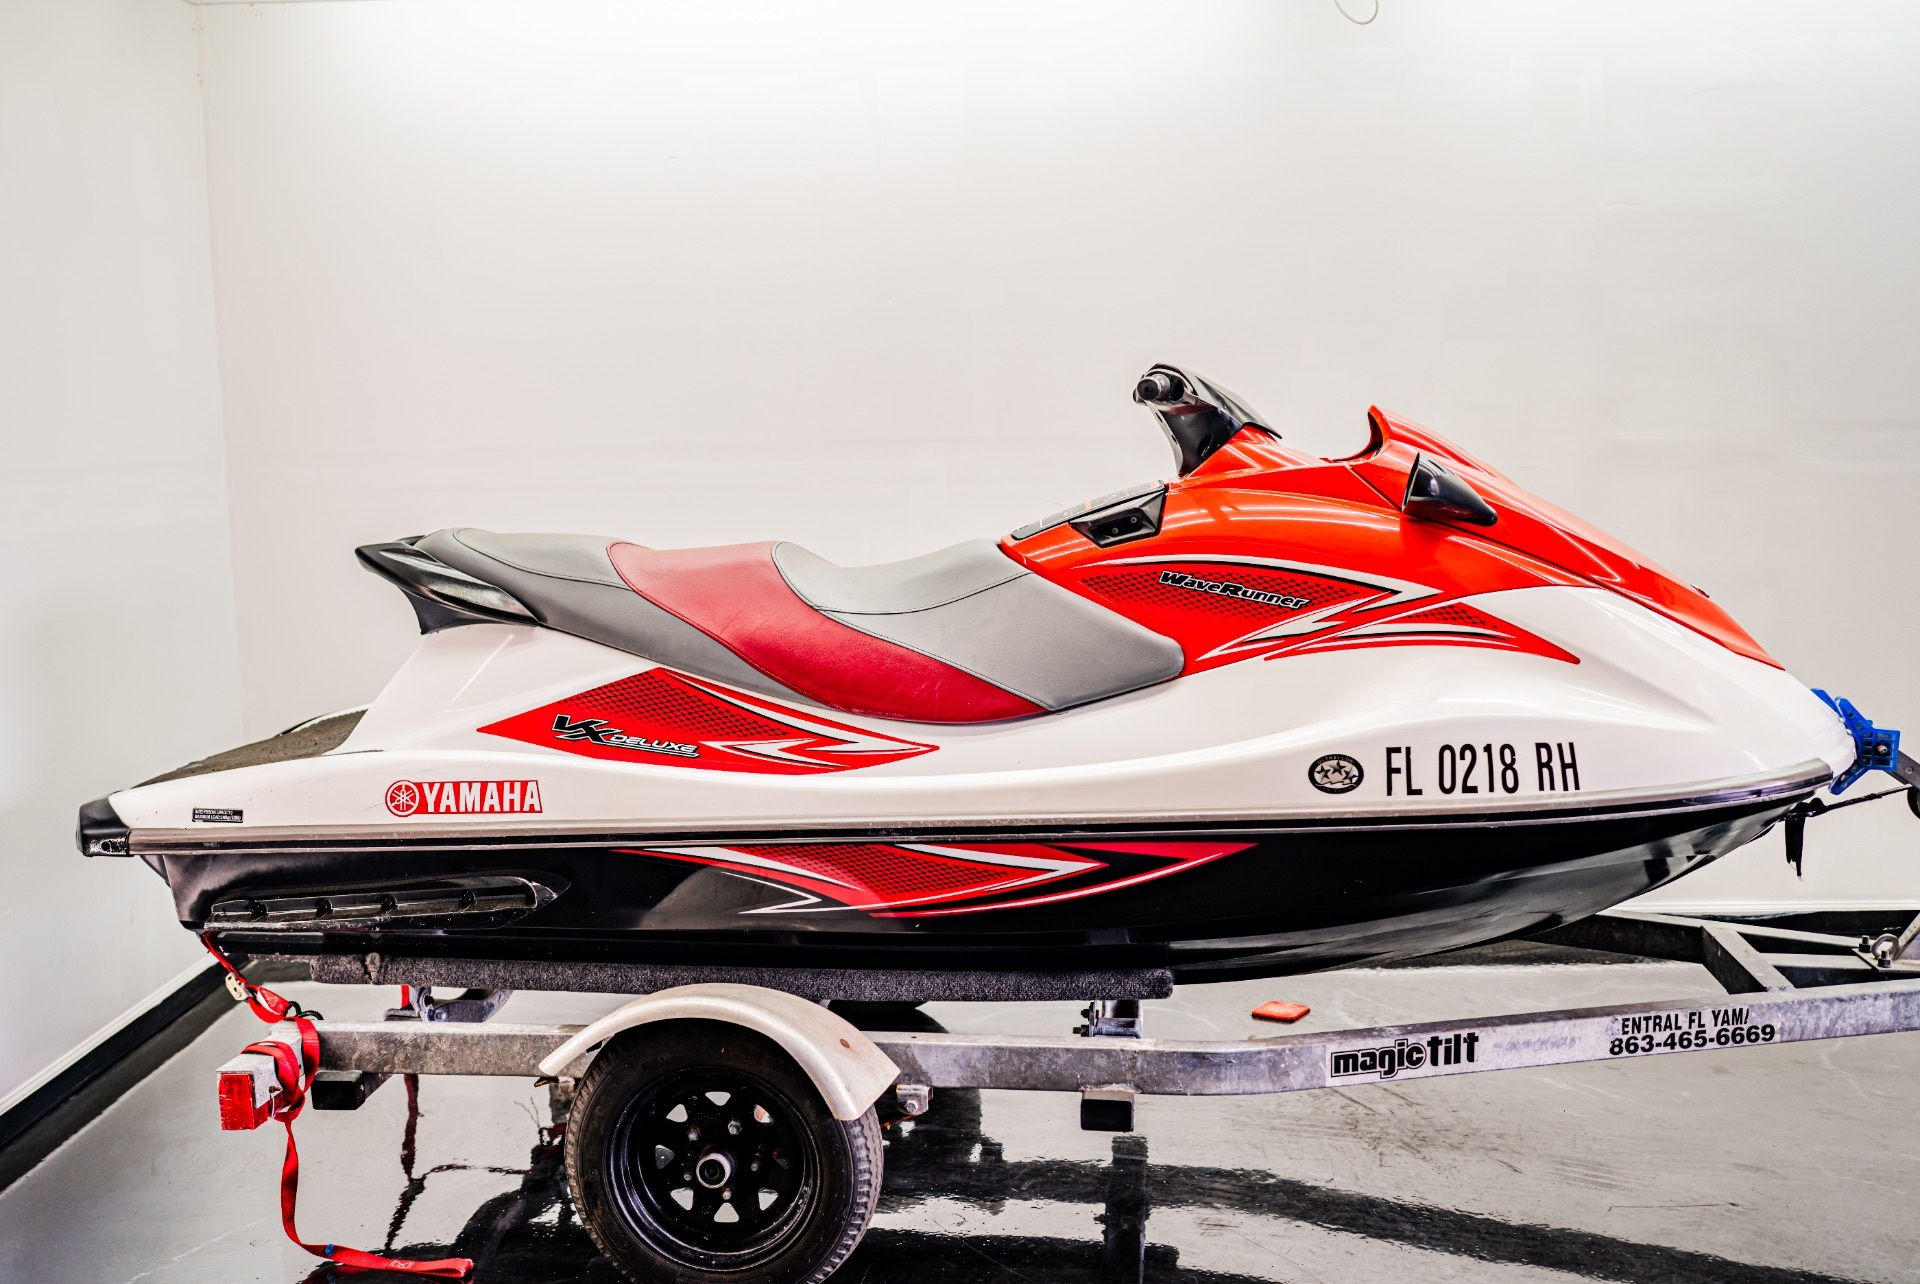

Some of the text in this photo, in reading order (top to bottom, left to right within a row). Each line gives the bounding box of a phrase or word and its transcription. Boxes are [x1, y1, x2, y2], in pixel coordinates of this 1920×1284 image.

[1159, 570, 1310, 609] WaveRunner
[552, 714, 698, 753] VX DELUXE
[1386, 742, 1580, 796] FL 0218 RH
[421, 781, 541, 813] YAMAHA
[1609, 1024, 1776, 1056] 863-465-6669
[1620, 1013, 1682, 1035] ENTRAL
[1688, 1011, 1706, 1029] FL
